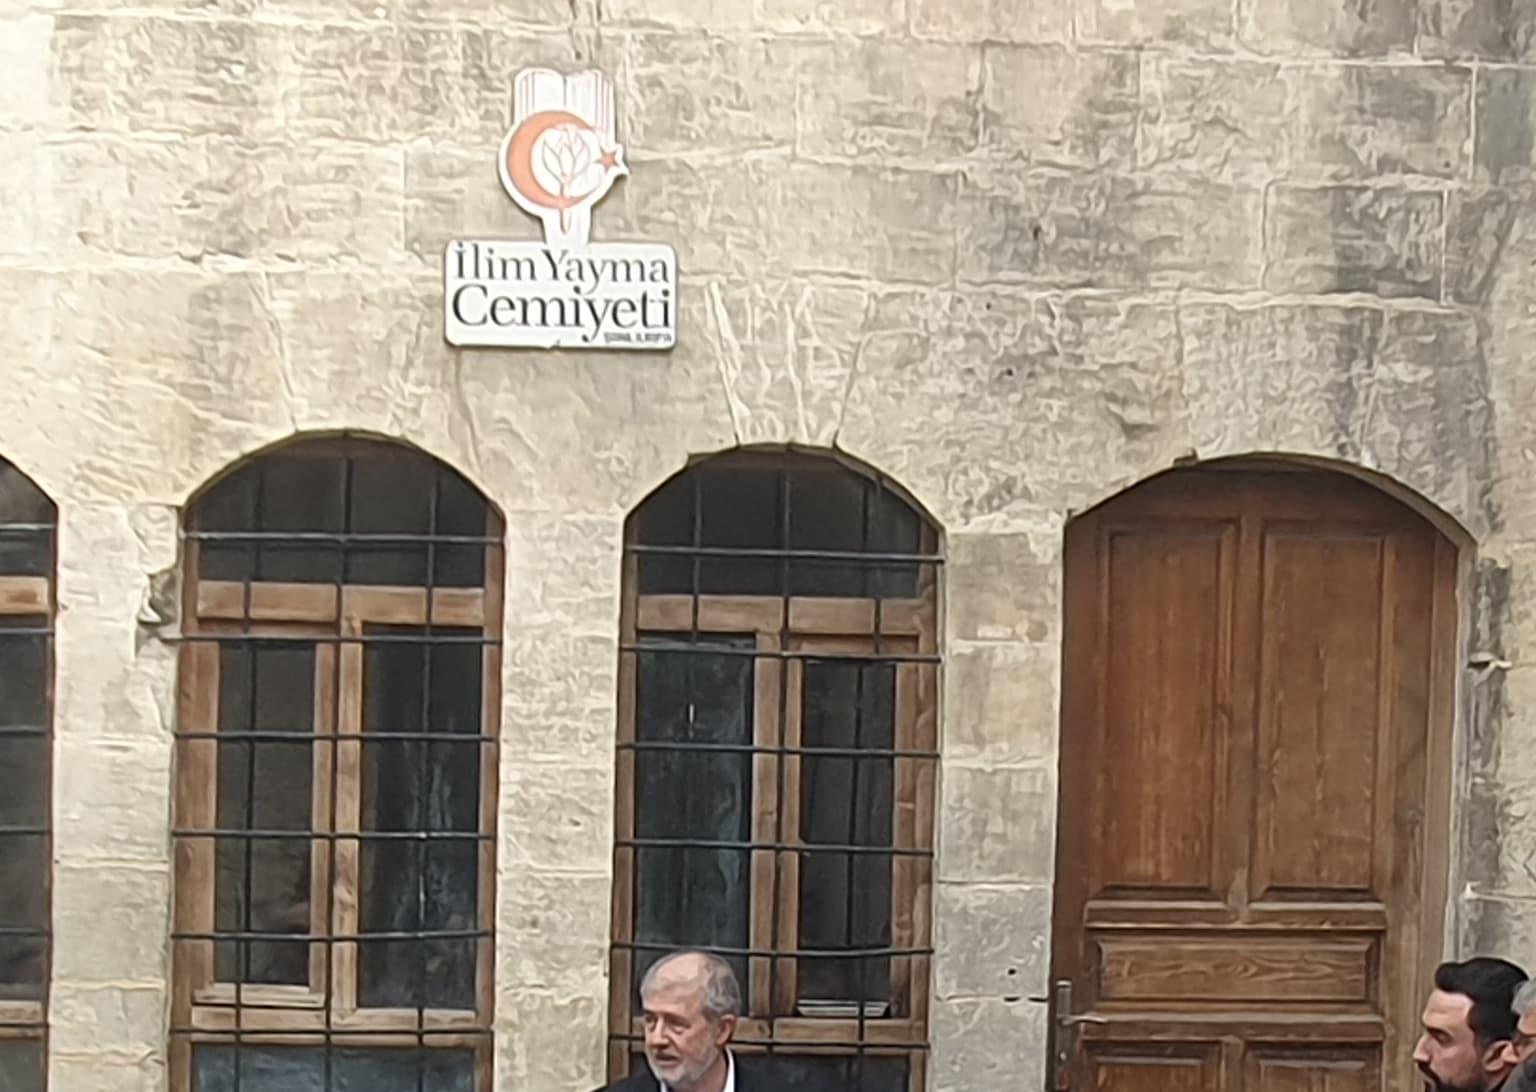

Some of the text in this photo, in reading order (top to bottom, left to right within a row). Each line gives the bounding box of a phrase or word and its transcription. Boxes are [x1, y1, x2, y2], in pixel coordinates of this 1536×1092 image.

[454, 241, 670, 294] İlim Yayma
[452, 284, 671, 342] Cemiyeti
